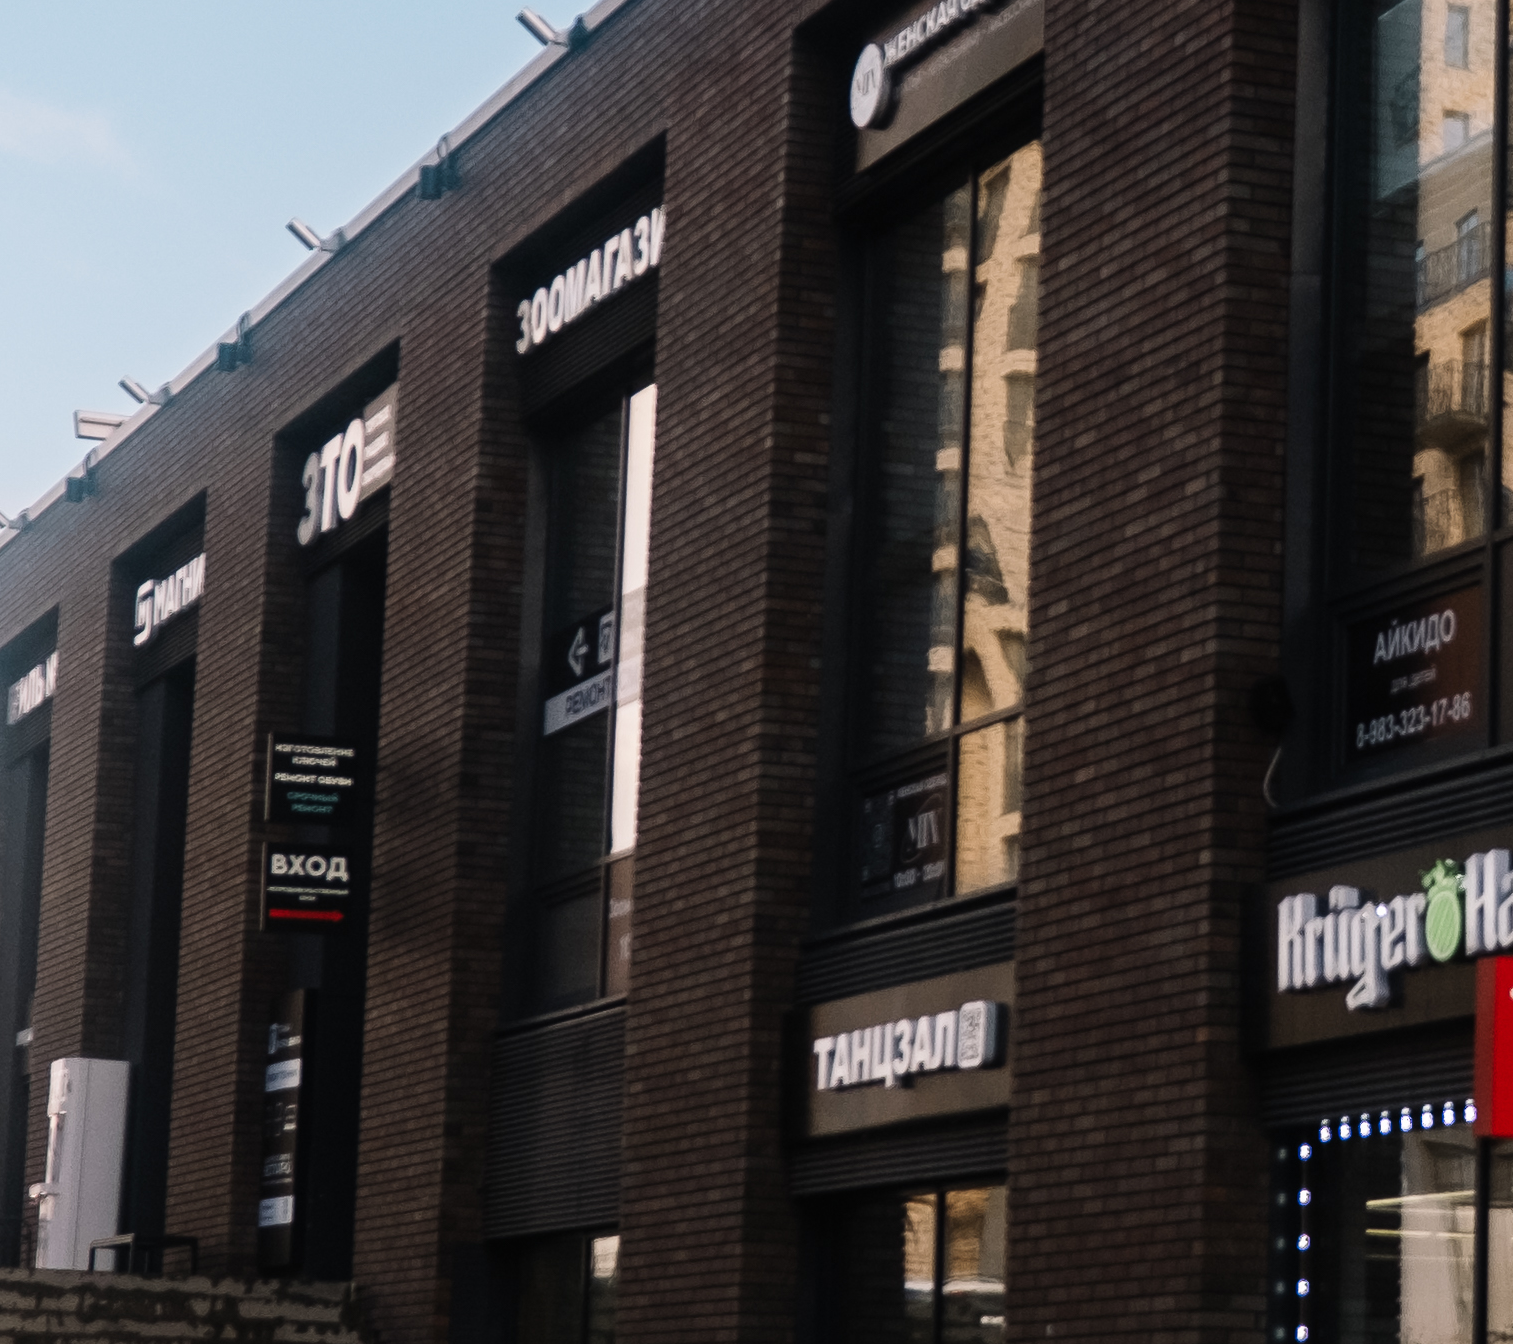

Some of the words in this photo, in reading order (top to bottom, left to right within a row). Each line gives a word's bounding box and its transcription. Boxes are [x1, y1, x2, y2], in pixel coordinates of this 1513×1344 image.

[1373, 607, 1458, 666] АЙКИДО
[270, 853, 351, 883] ВХОД
[1277, 884, 1426, 1011] Krüger
[813, 1009, 959, 1091] ТАНЦЗАЛ
